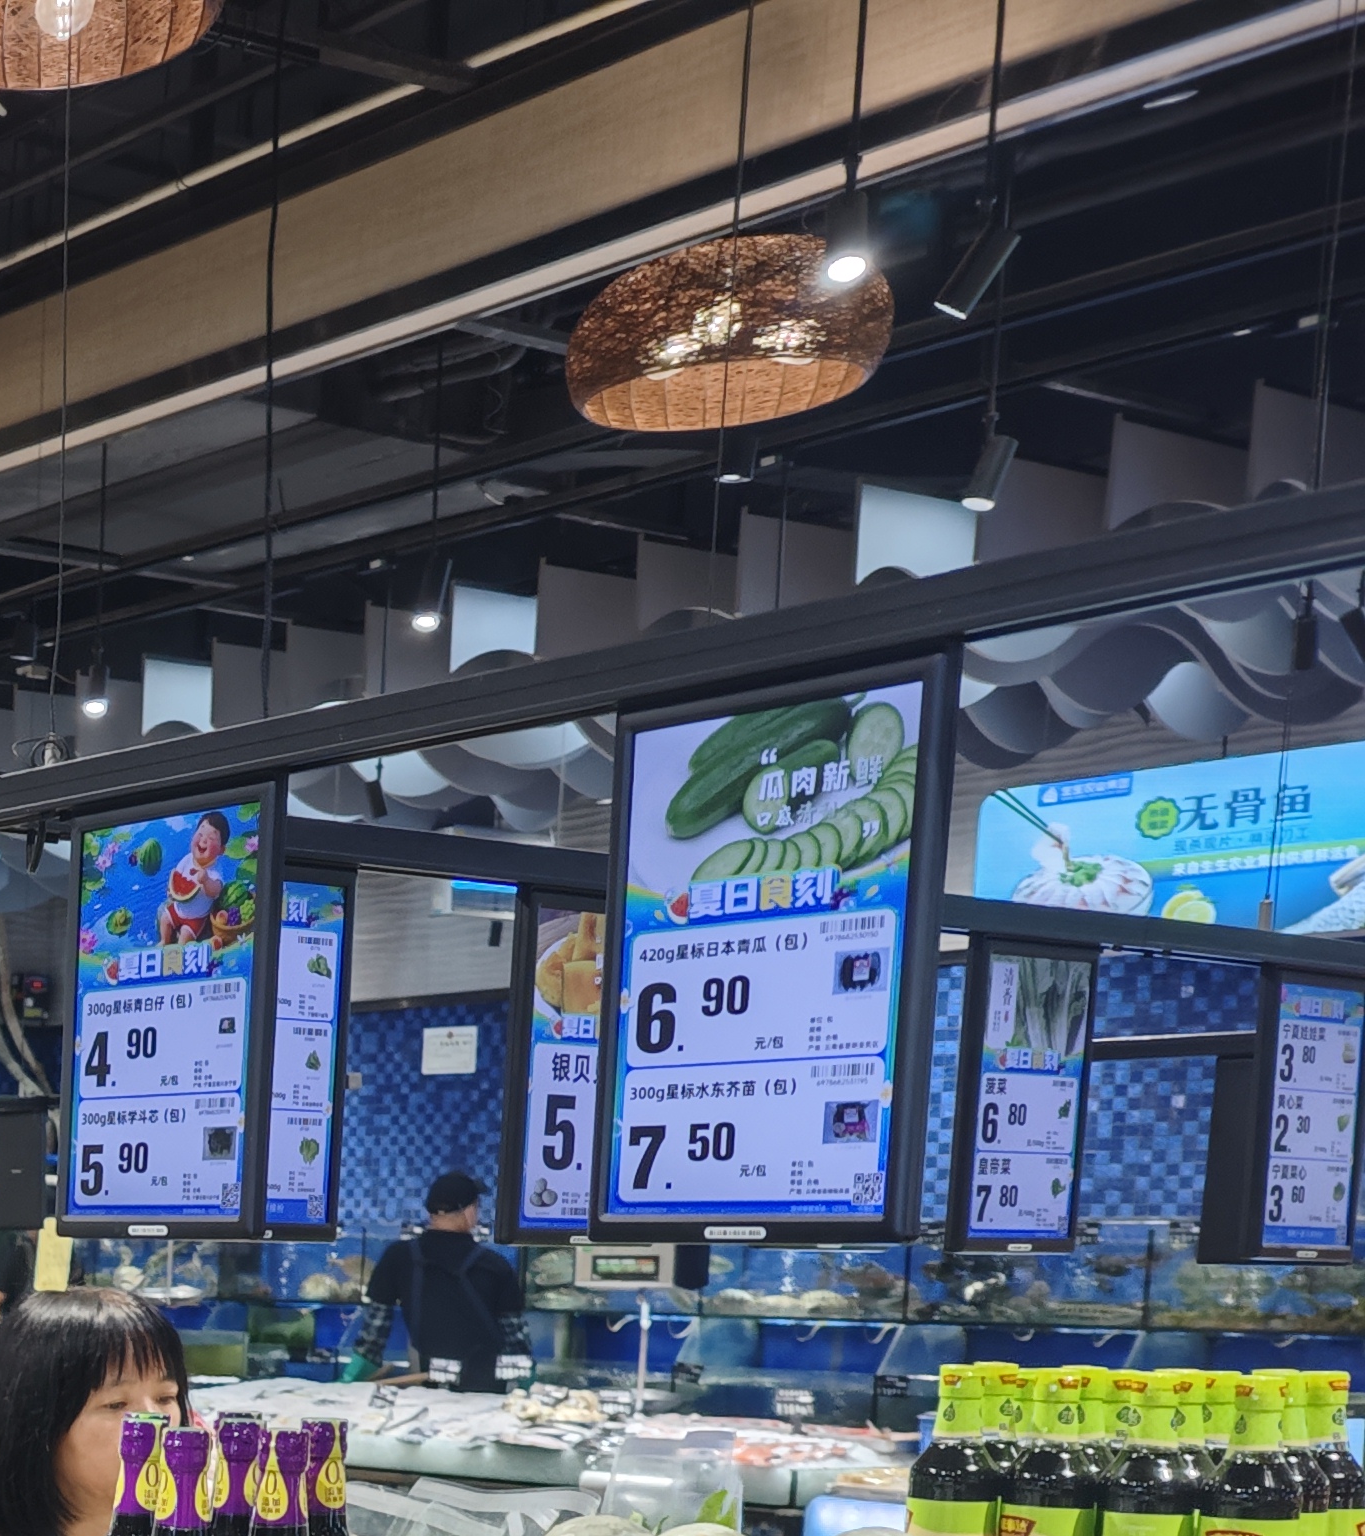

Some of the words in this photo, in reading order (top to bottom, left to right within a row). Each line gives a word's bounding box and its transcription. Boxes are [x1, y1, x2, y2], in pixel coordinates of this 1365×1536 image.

[759, 755, 883, 801] 瓜肉新鲜
[1177, 784, 1312, 833] 无骨鱼
[689, 869, 834, 917] 夏日食刻
[117, 942, 211, 981] 夏日食刻
[639, 932, 808, 963] 420g星标日本青瓜（包）
[562, 1014, 599, 1039] 夏日
[754, 1036, 784, 1051] 元/包
[552, 1052, 598, 1083] 银贝
[629, 1078, 798, 1102] 300g星标水东芥苗（包）
[739, 1164, 767, 1178] 元/包
[977, 1157, 1011, 1176] 皇帝菜
